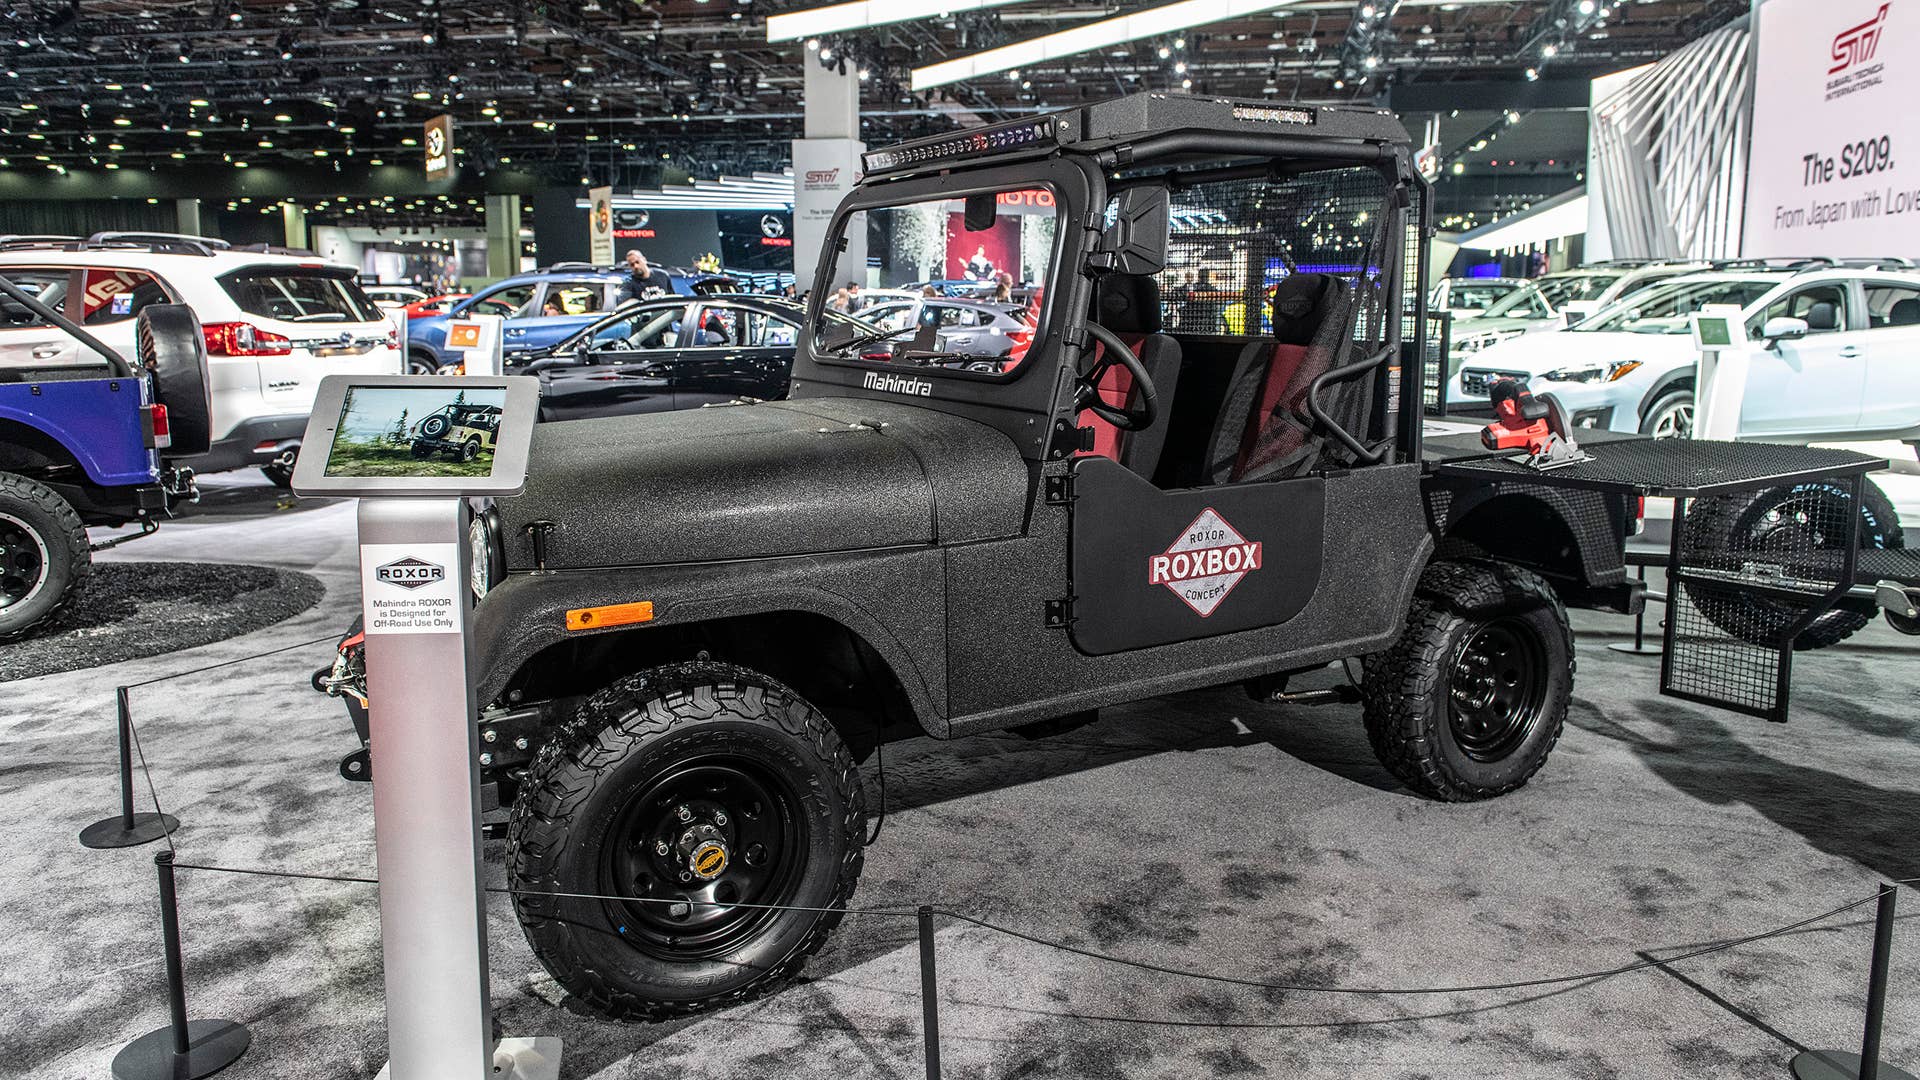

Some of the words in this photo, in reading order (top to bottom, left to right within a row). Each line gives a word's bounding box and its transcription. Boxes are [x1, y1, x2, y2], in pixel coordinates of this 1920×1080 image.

[1803, 153, 1834, 187] The
[1840, 134, 1895, 179] S209.
[1774, 205, 1805, 230] From
[1807, 200, 1848, 230] Japan
[1850, 189, 1882, 219] with
[863, 371, 932, 397] Mahindra
[1190, 530, 1225, 545] ROXOR
[1153, 543, 1257, 583] ROXBOX
[380, 568, 441, 579] ROXOR
[1185, 583, 1227, 600] CONCEPT
[373, 599, 416, 608] Mahindra
[418, 598, 452, 607] ROXOR
[380, 610, 387, 618] is
[390, 609, 431, 619] Designed
[433, 608, 447, 617] for
[373, 619, 412, 628] Off-Road
[414, 619, 432, 627] Use
[433, 618, 454, 628] Only
